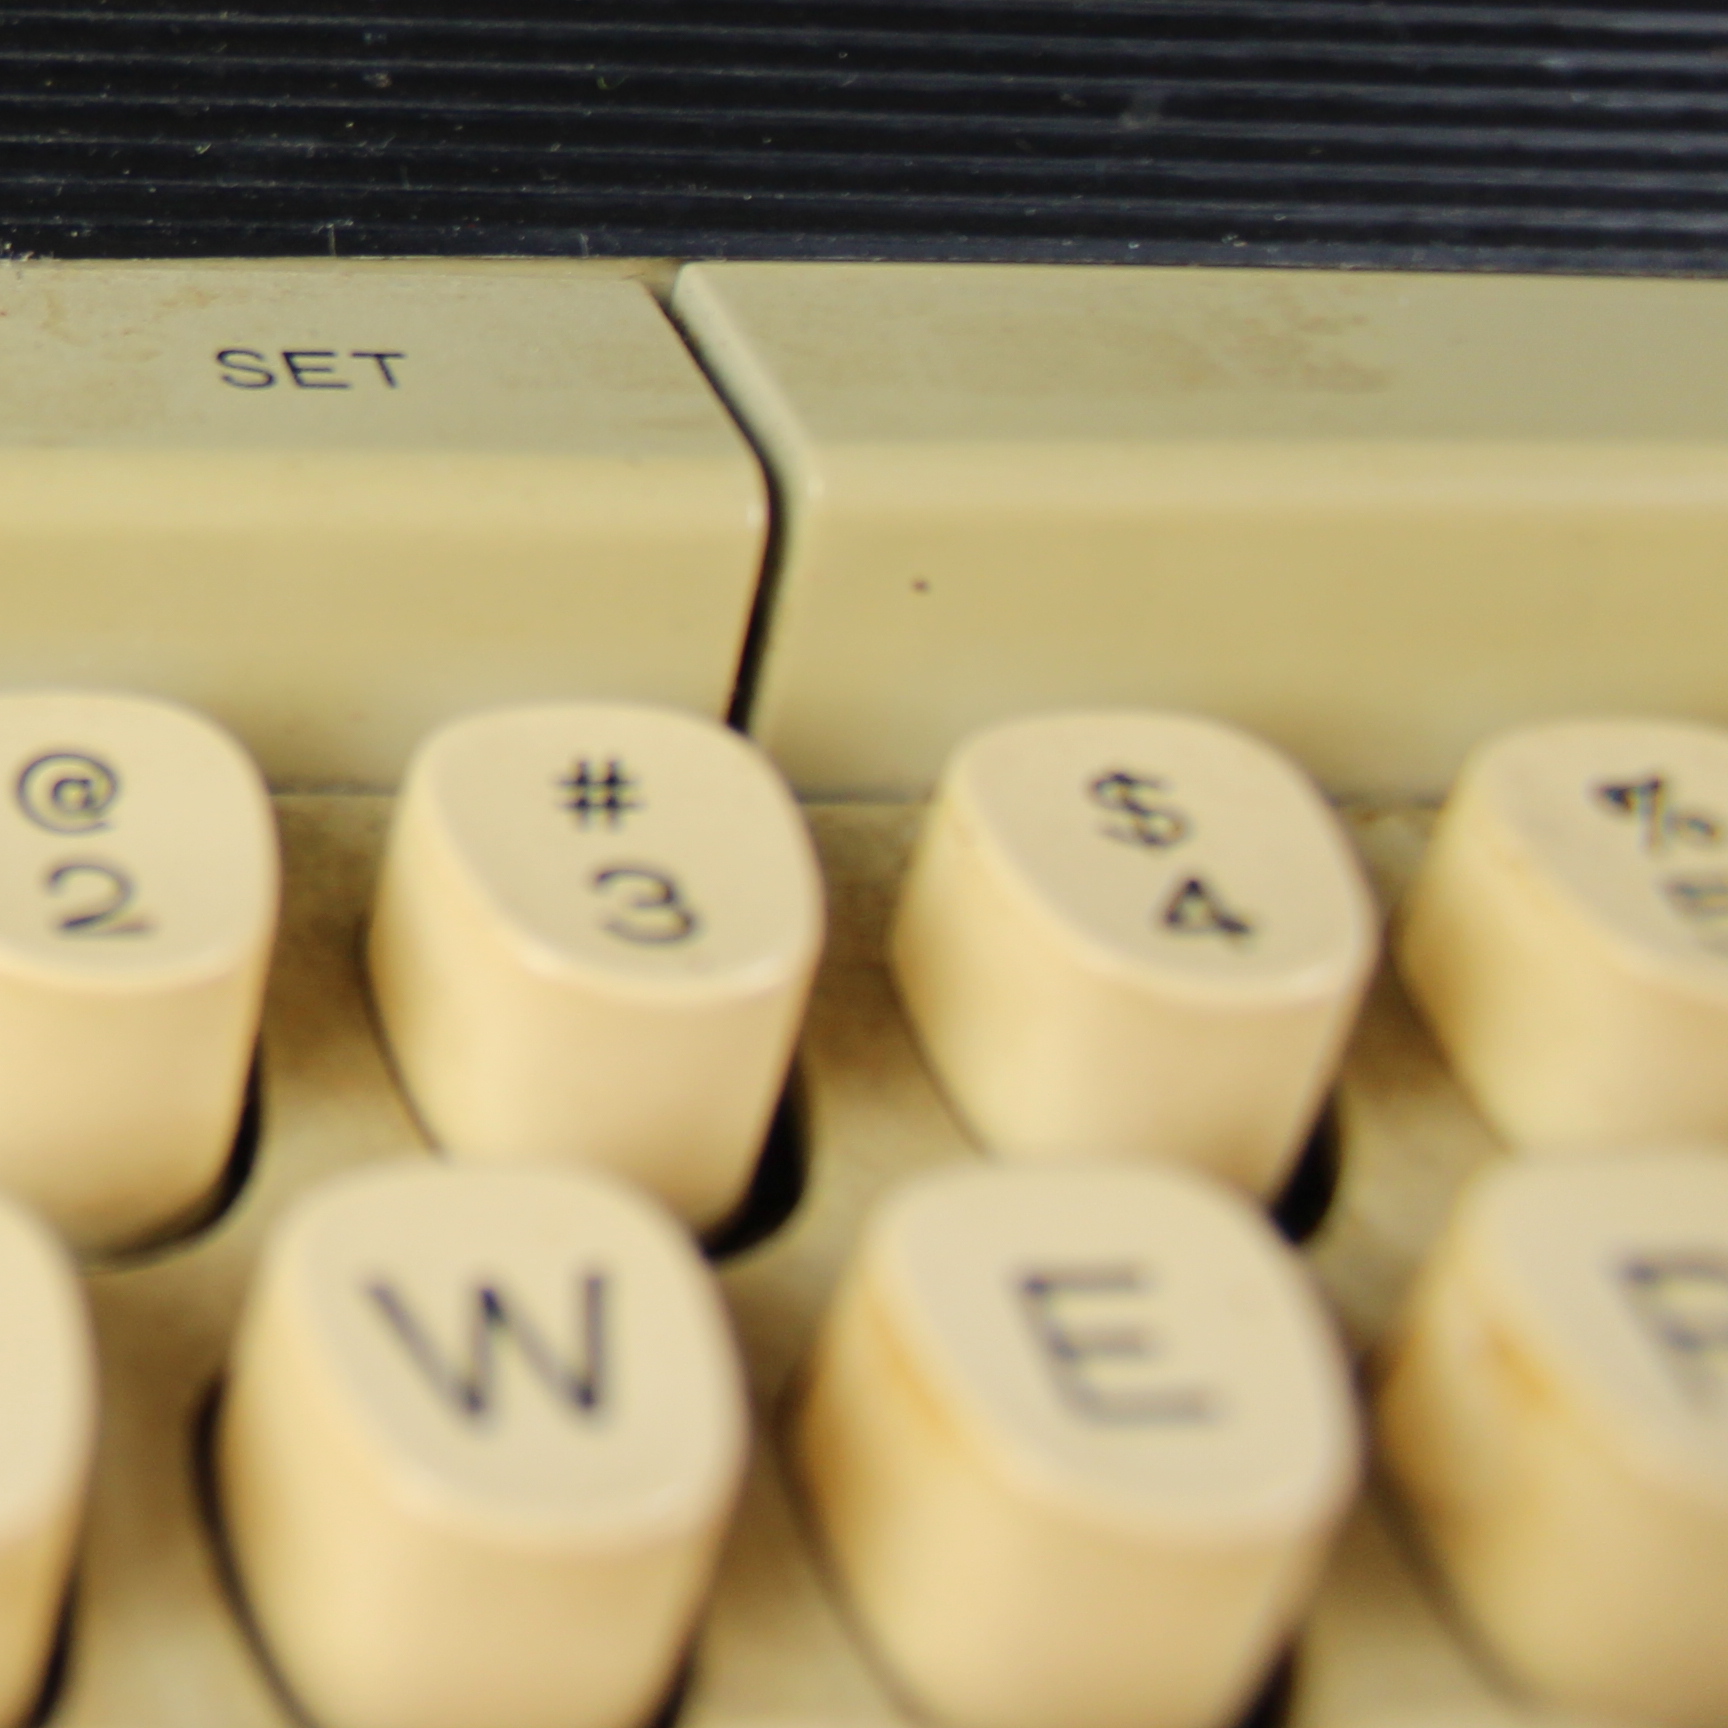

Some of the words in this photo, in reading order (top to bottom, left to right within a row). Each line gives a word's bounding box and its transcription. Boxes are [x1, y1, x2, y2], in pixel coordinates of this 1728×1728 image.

[216, 349, 406, 390] SET
[14, 750, 120, 836] @
[557, 758, 640, 830] #
[1084, 770, 1193, 850] $
[44, 860, 156, 938] 2
[590, 864, 702, 949] 3
[1158, 876, 1262, 946] 4
[361, 1268, 612, 1424] W
[1016, 1262, 1227, 1426] E
